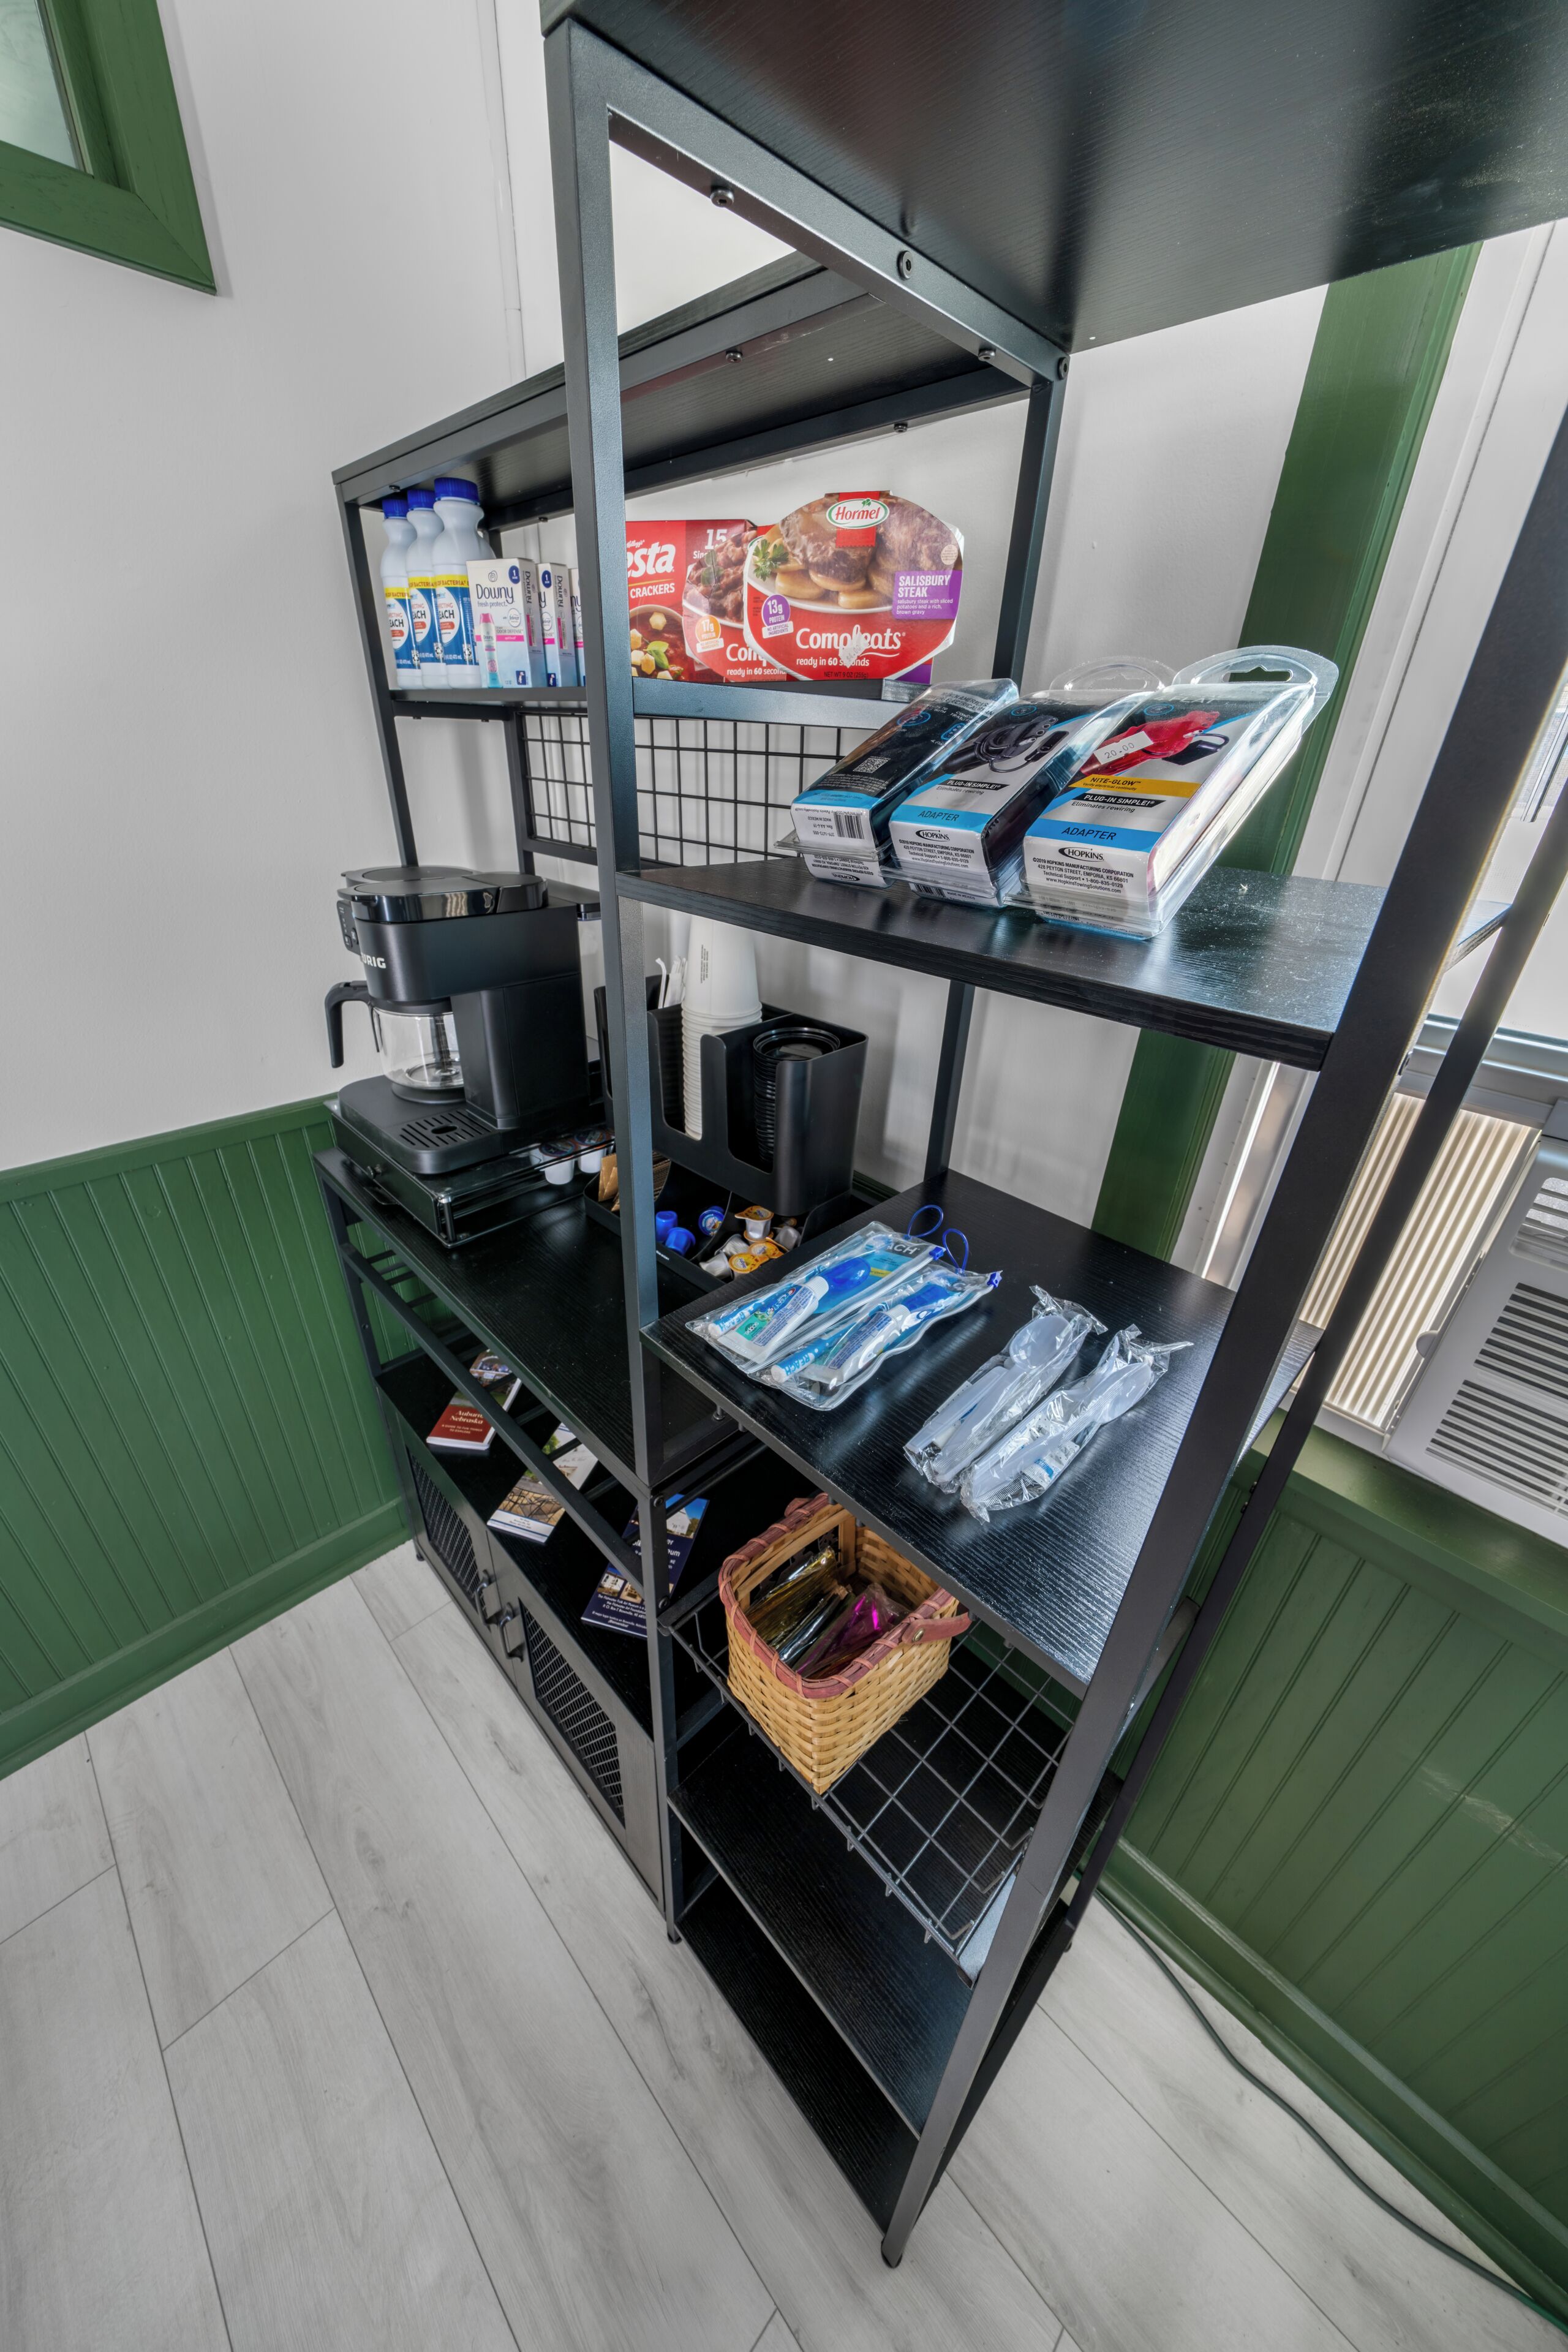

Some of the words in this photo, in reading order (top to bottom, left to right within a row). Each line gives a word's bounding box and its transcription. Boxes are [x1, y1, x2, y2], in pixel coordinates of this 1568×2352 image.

[835, 507, 880, 521] Hormel
[899, 575, 951, 586] SALISBURY
[476, 584, 516, 604] Downy
[630, 582, 675, 598] CRACKERS
[897, 587, 927, 597] STEAK
[767, 599, 783, 614] 13g
[769, 614, 785, 624] PROTEIN
[701, 619, 714, 632] 17g
[796, 657, 818, 668] ready
[819, 657, 826, 665] in
[827, 657, 838, 666] 60
[839, 657, 870, 666] sonds
[727, 668, 745, 677] ready
[1084, 794, 1115, 803] PLUG-IN
[918, 810, 960, 821] ADAPTER
[1061, 827, 1117, 840] ADAPTER
[1068, 849, 1104, 861] HOPKINS
[1065, 862, 1101, 872] MANUFACTURING
[1102, 868, 1134, 878] CORPORATION
[1046, 876, 1121, 894] www.HopkinsTowingSolutions.com
[1085, 878, 1123, 888] 1-800-835-0129
[785, 1354, 810, 1376] REACH
[450, 1415, 483, 1424] Nebraska
